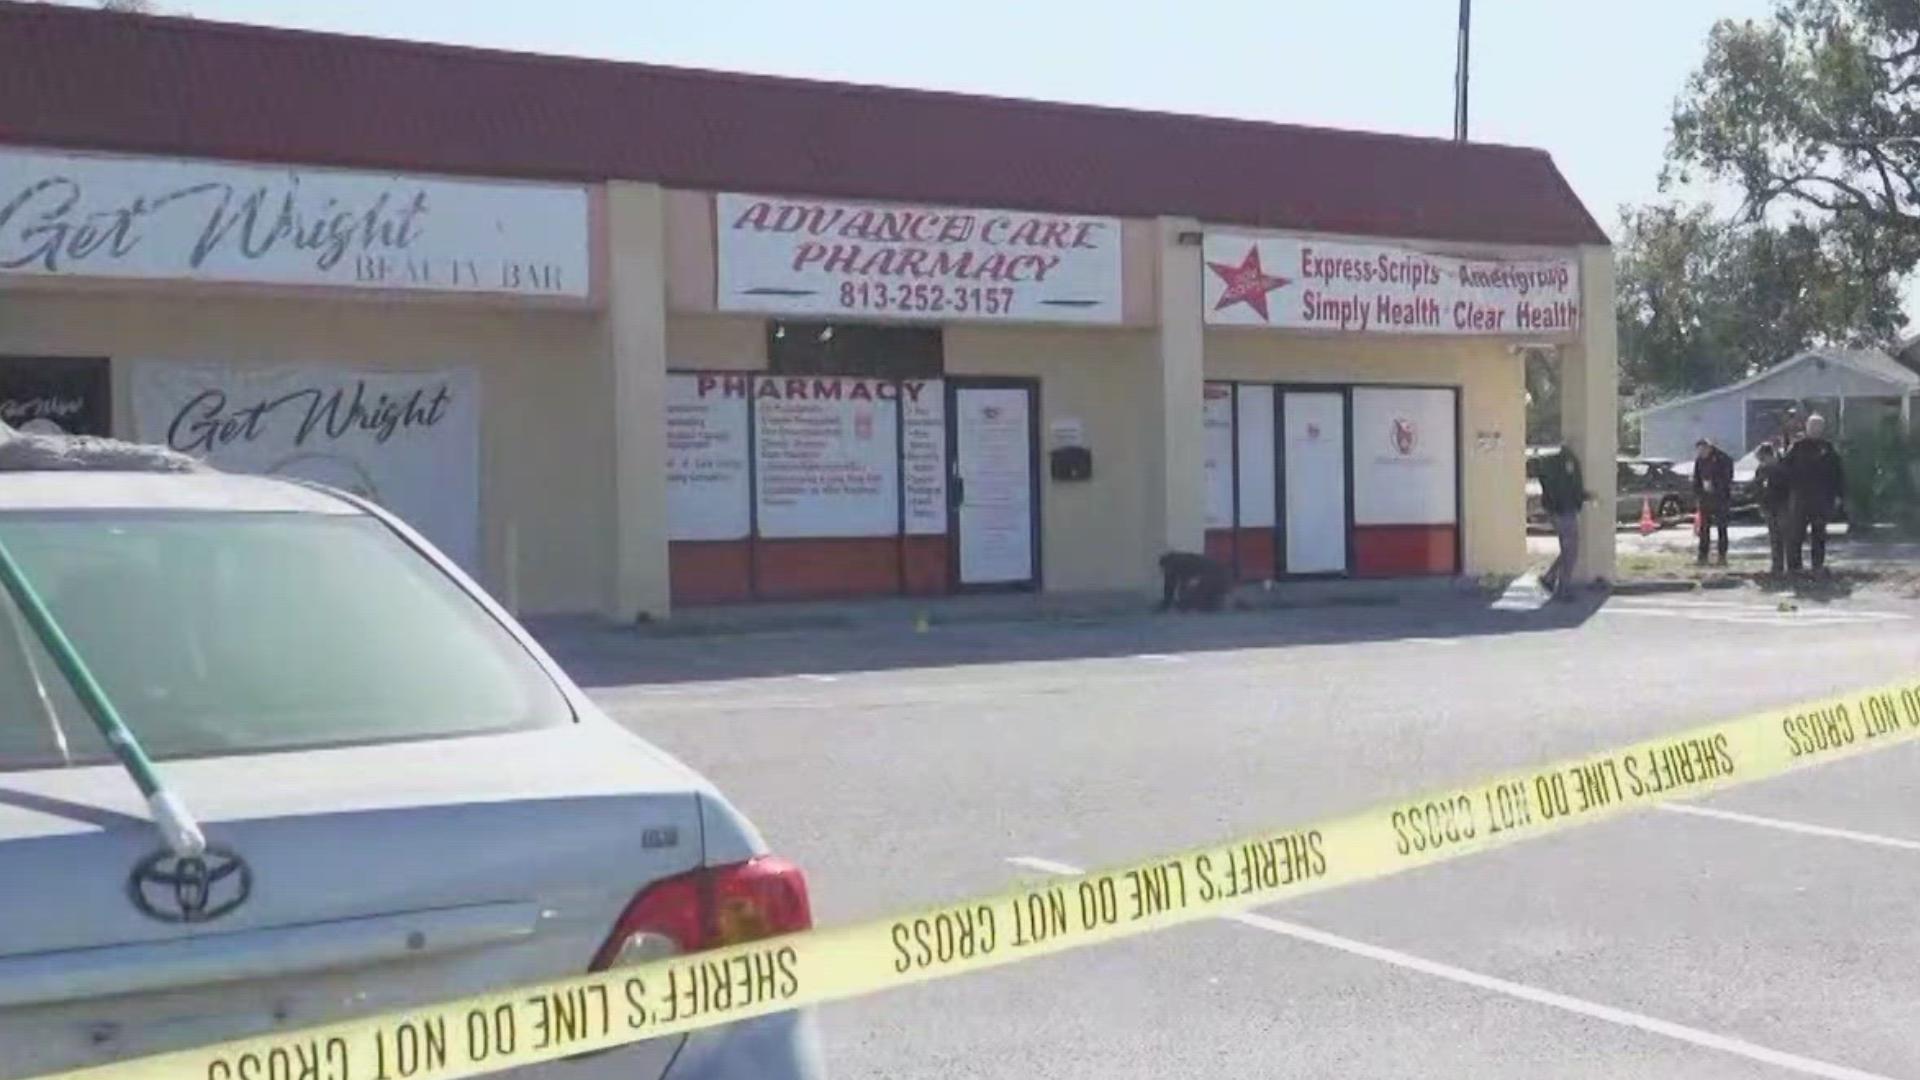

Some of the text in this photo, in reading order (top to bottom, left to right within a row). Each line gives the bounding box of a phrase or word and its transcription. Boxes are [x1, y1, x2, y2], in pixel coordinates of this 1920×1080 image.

[0, 174, 427, 271] Get Wright
[981, 217, 1107, 249] CARE
[792, 243, 1060, 281] PHARMACY
[1302, 249, 1439, 290] Express-Scripts
[1459, 262, 1569, 294] Amerigroup
[839, 281, 1014, 314] 813-252-3157
[1303, 292, 1578, 330] Simply Health Clear Health
[167, 380, 450, 451] Get Wright
[697, 375, 925, 402] PHARMACY
[1783, 703, 1854, 756] CROSS
[1859, 692, 1900, 738] NOT
[1570, 757, 1622, 812] LINE
[1624, 733, 1734, 798] SHERIFF'S
[1535, 774, 1570, 820] DO
[1391, 796, 1475, 855] CROSS
[892, 830, 1326, 973] SHERIFF'S LINE DO NOT CROSS
[625, 945, 798, 1028] SHERIFF'S
[467, 1004, 515, 1061] DO
[529, 983, 609, 1049] LINE
[375, 1015, 446, 1079] NOT
